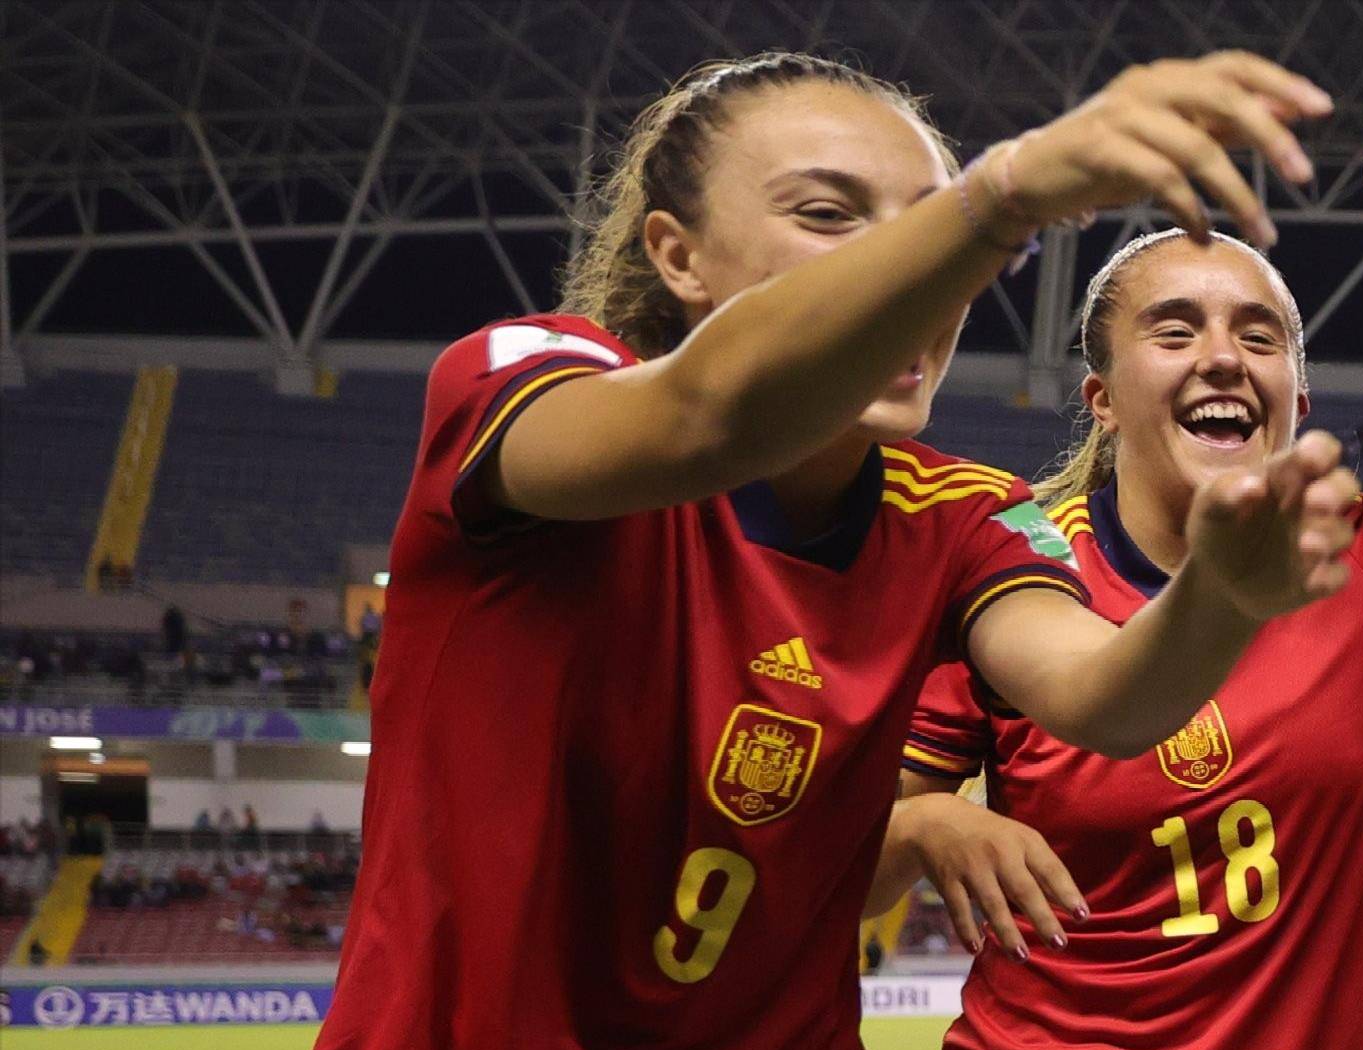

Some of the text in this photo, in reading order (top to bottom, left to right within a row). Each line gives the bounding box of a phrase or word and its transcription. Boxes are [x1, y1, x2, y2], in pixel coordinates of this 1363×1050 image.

[749, 659, 823, 689] adidas
[653, 847, 757, 983] 9
[1151, 799, 1280, 938] 18
